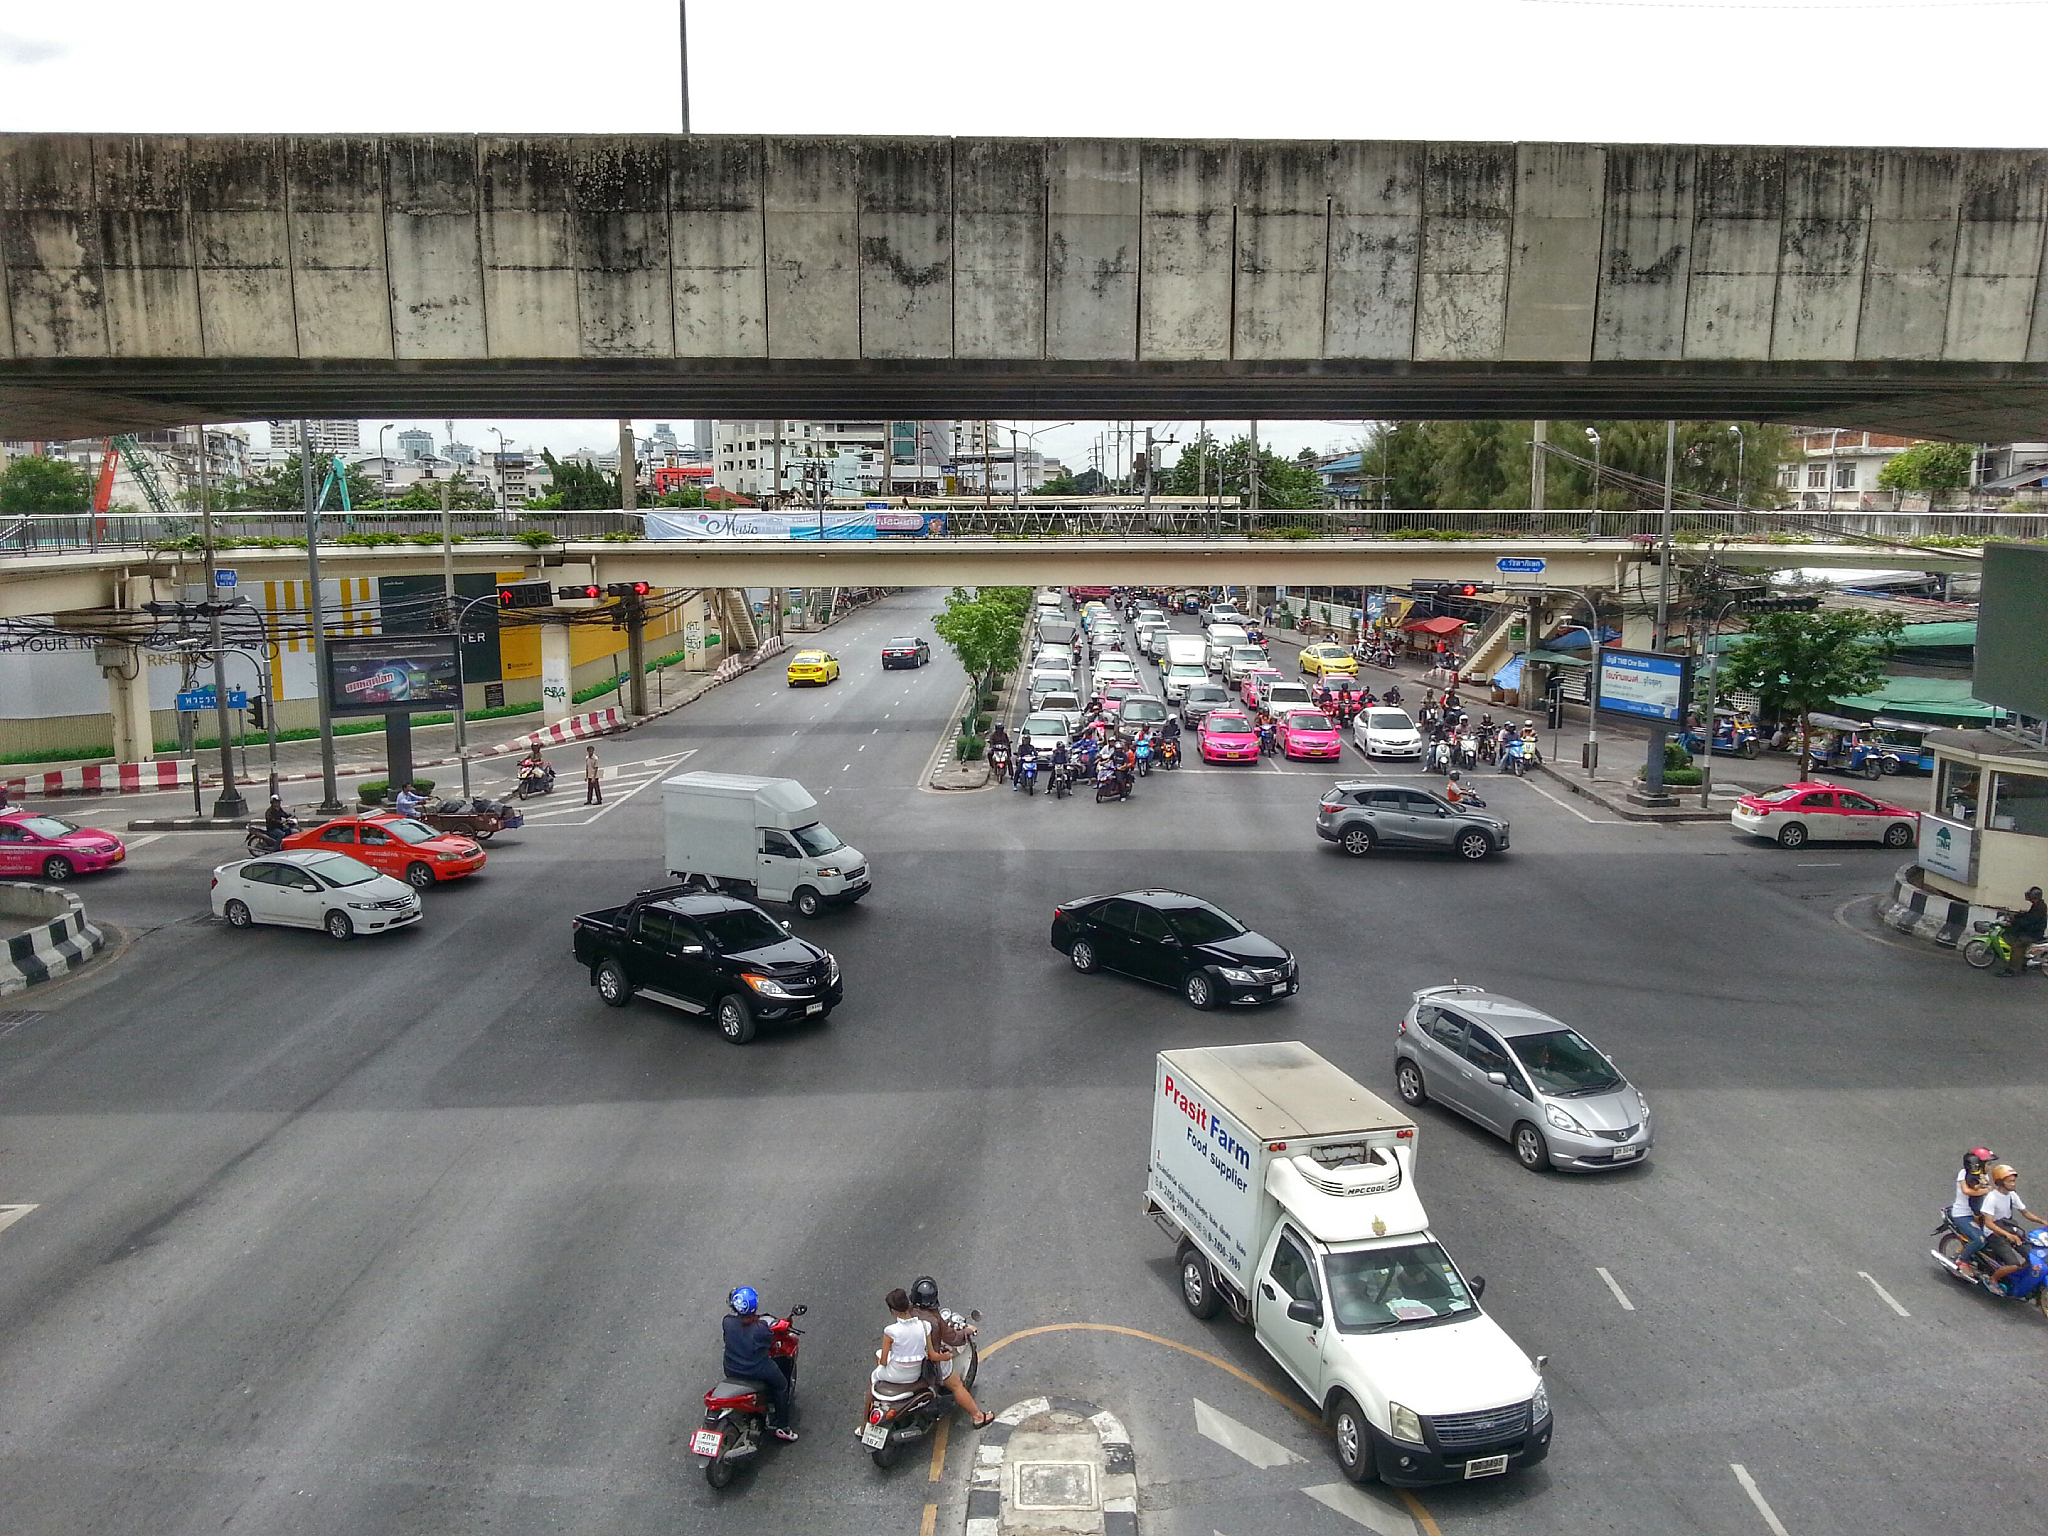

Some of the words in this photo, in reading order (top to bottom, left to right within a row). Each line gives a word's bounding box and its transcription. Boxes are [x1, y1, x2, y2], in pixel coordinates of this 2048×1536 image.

[706, 513, 758, 538] Music
[17, 638, 68, 653] YOUR
[1638, 660, 1649, 668] Bank
[1164, 1074, 1207, 1131] Prasit
[1210, 1114, 1250, 1170] Farm
[1187, 1126, 1208, 1158] Food
[1210, 1152, 1248, 1194] supplier
